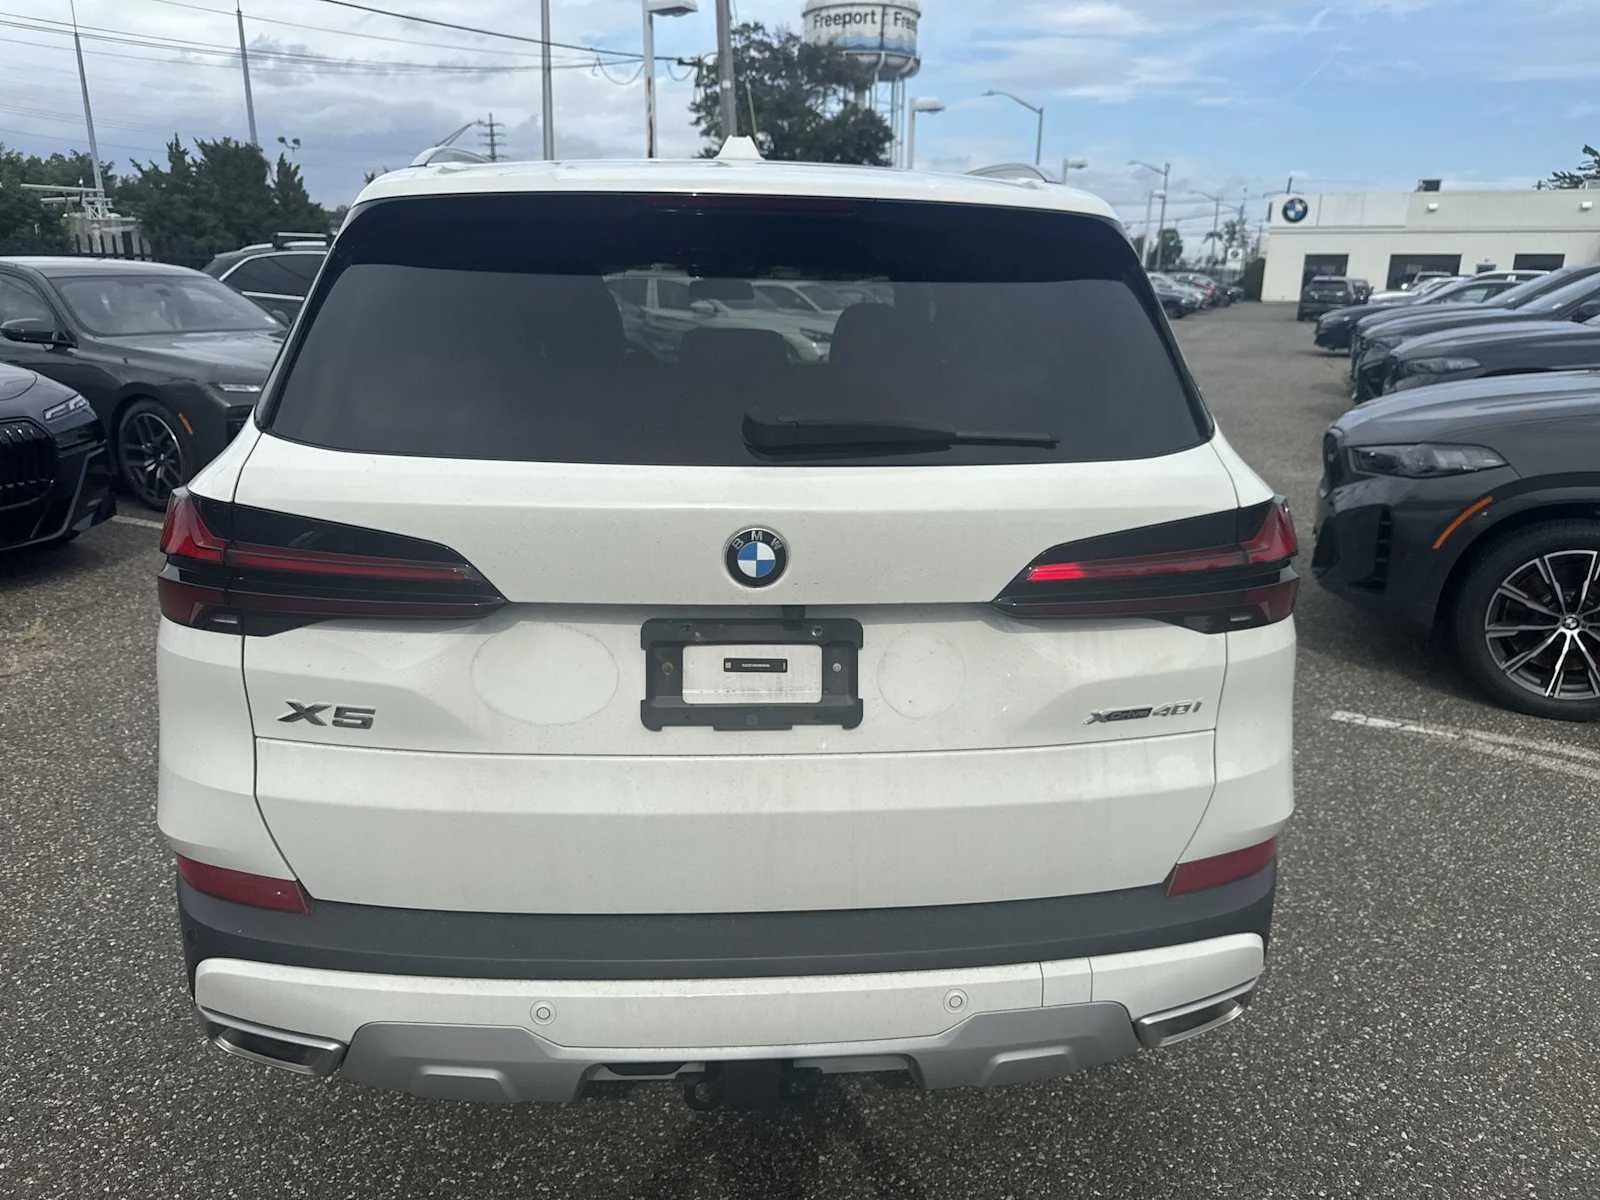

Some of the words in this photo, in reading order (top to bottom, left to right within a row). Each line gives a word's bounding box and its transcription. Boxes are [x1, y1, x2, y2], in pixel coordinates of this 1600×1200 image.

[812, 9, 877, 30] Freeport
[732, 530, 784, 550] BMW
[277, 700, 376, 730] X5
